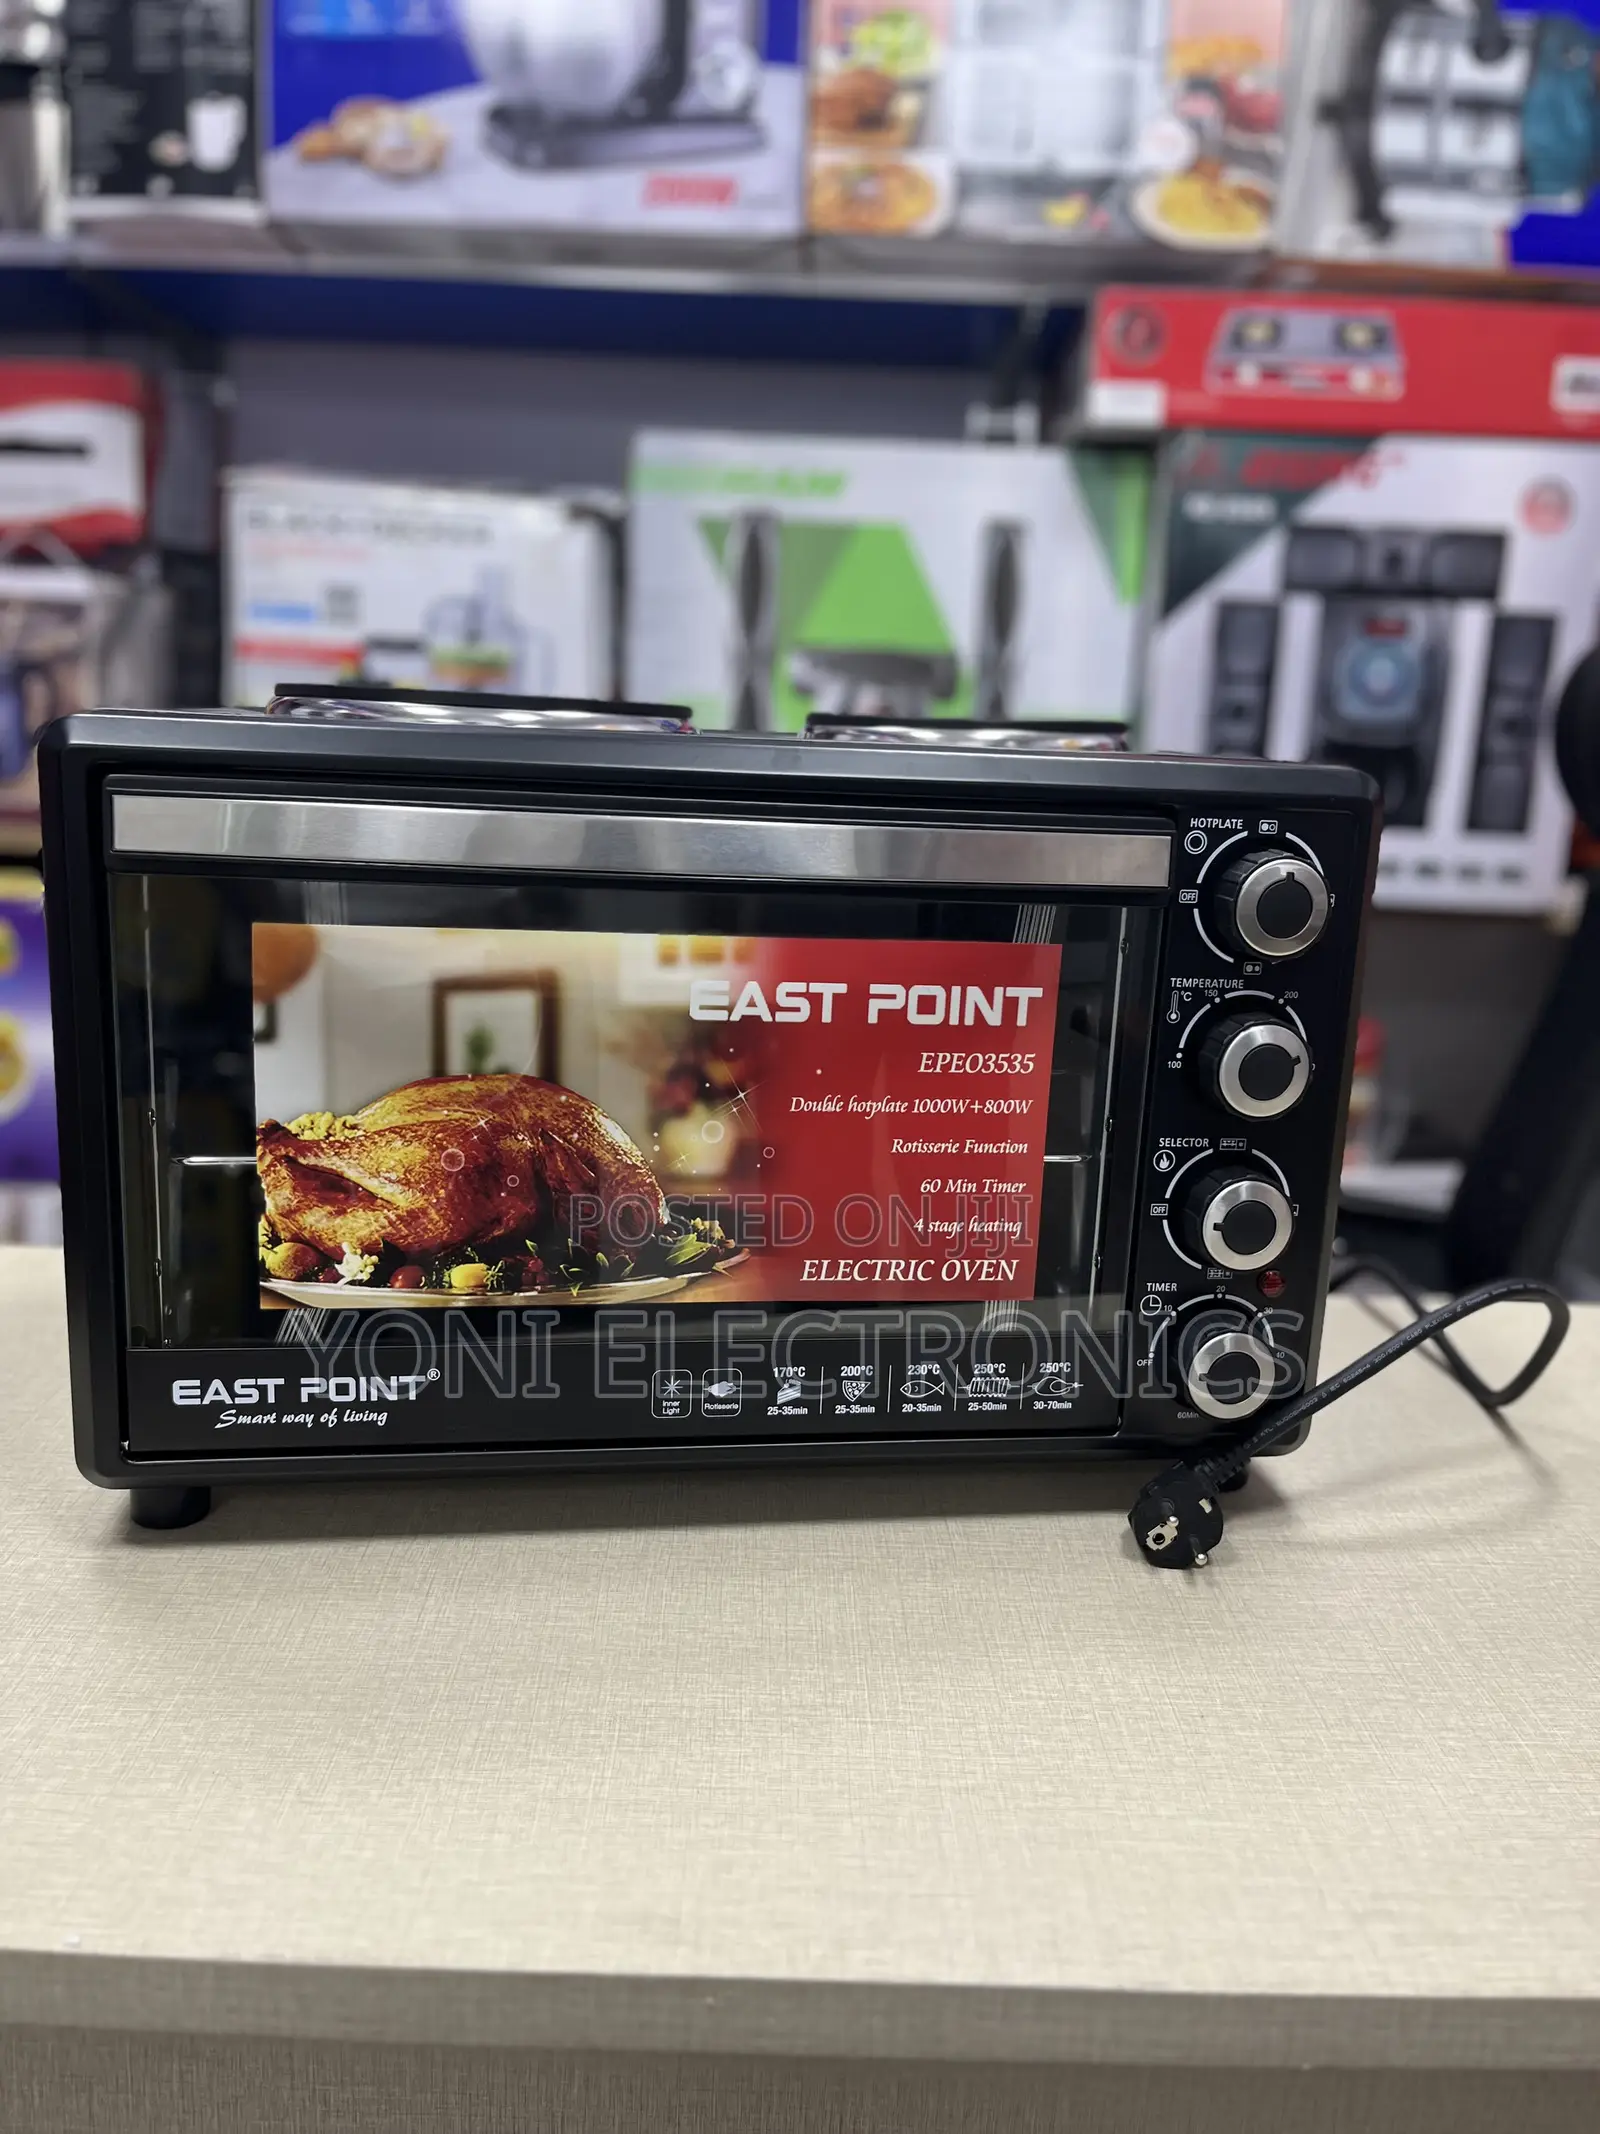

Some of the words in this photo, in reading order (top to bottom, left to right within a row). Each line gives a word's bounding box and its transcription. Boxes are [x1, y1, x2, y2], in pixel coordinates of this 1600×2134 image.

[1190, 817, 1243, 830] HOTPLATE
[1181, 892, 1196, 901] OFF
[1170, 977, 1244, 989] TEMPERATURE
[1204, 988, 1219, 998] 150
[1284, 990, 1299, 999] 200
[689, 980, 848, 1024] EAST
[868, 983, 1044, 1028] POINT
[1167, 1060, 1182, 1069] 100
[789, 1095, 844, 1113] Double
[848, 1096, 908, 1120] hotplate
[912, 1097, 1033, 1116] 1000W+800W
[891, 1138, 960, 1155] Rotisserie
[964, 1139, 1028, 1155] Function
[1159, 1137, 1209, 1148] SELECTOR
[920, 1178, 942, 1194] 60
[944, 1178, 978, 1194] Min
[982, 1178, 1027, 1195] Timer
[1152, 1205, 1166, 1214] OFF
[913, 1219, 924, 1233] 4
[928, 1219, 965, 1240] stage
[968, 1216, 1023, 1239] heating
[799, 1258, 935, 1283] ELECTRIC
[941, 1258, 1019, 1283] OVEN
[1146, 1282, 1178, 1292] TIMER
[1216, 1285, 1226, 1293] 20
[1164, 1304, 1173, 1312] 10
[1263, 1306, 1274, 1315] 30
[1039, 1361, 1072, 1375] 250°C
[1136, 1358, 1153, 1367] OFF
[772, 1364, 806, 1378] 170°C
[840, 1363, 874, 1378] 200°C
[907, 1362, 941, 1377] 230°C
[974, 1362, 1007, 1376] 250°C
[172, 1378, 285, 1406] EAST
[704, 1402, 739, 1410] Rotisserie
[767, 1404, 808, 1416] 25-35min
[834, 1403, 876, 1415] 25-35min
[901, 1402, 943, 1414] 20-35min
[967, 1401, 1008, 1412] 25-50min
[1032, 1399, 1073, 1411] 30-70min
[662, 1407, 681, 1416] Light
[214, 1409, 277, 1429] Smart
[281, 1411, 315, 1427] way
[320, 1408, 338, 1428] of
[343, 1408, 388, 1426] living
